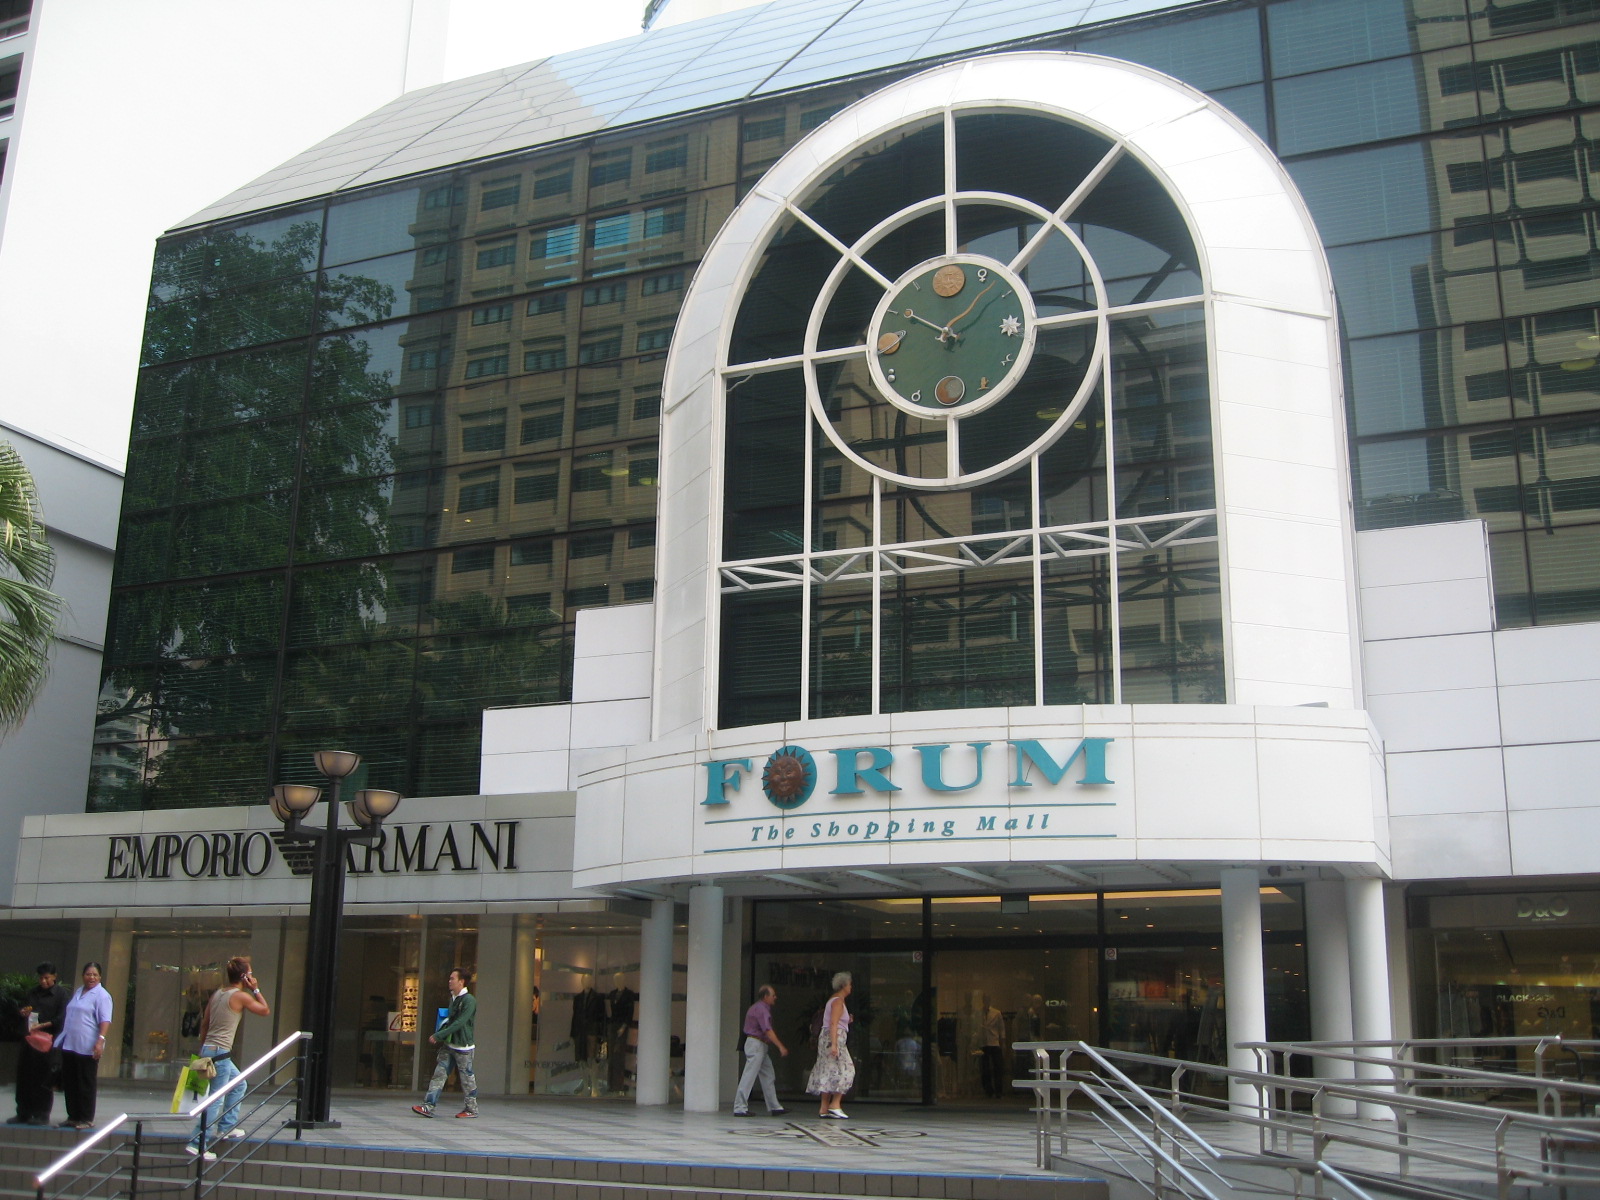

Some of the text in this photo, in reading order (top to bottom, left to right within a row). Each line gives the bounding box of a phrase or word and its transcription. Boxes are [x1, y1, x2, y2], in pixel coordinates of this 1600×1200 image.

[700, 737, 1115, 810] FORUM
[751, 813, 1051, 842] The Shopping Mall
[105, 831, 272, 879] EMPORIO
